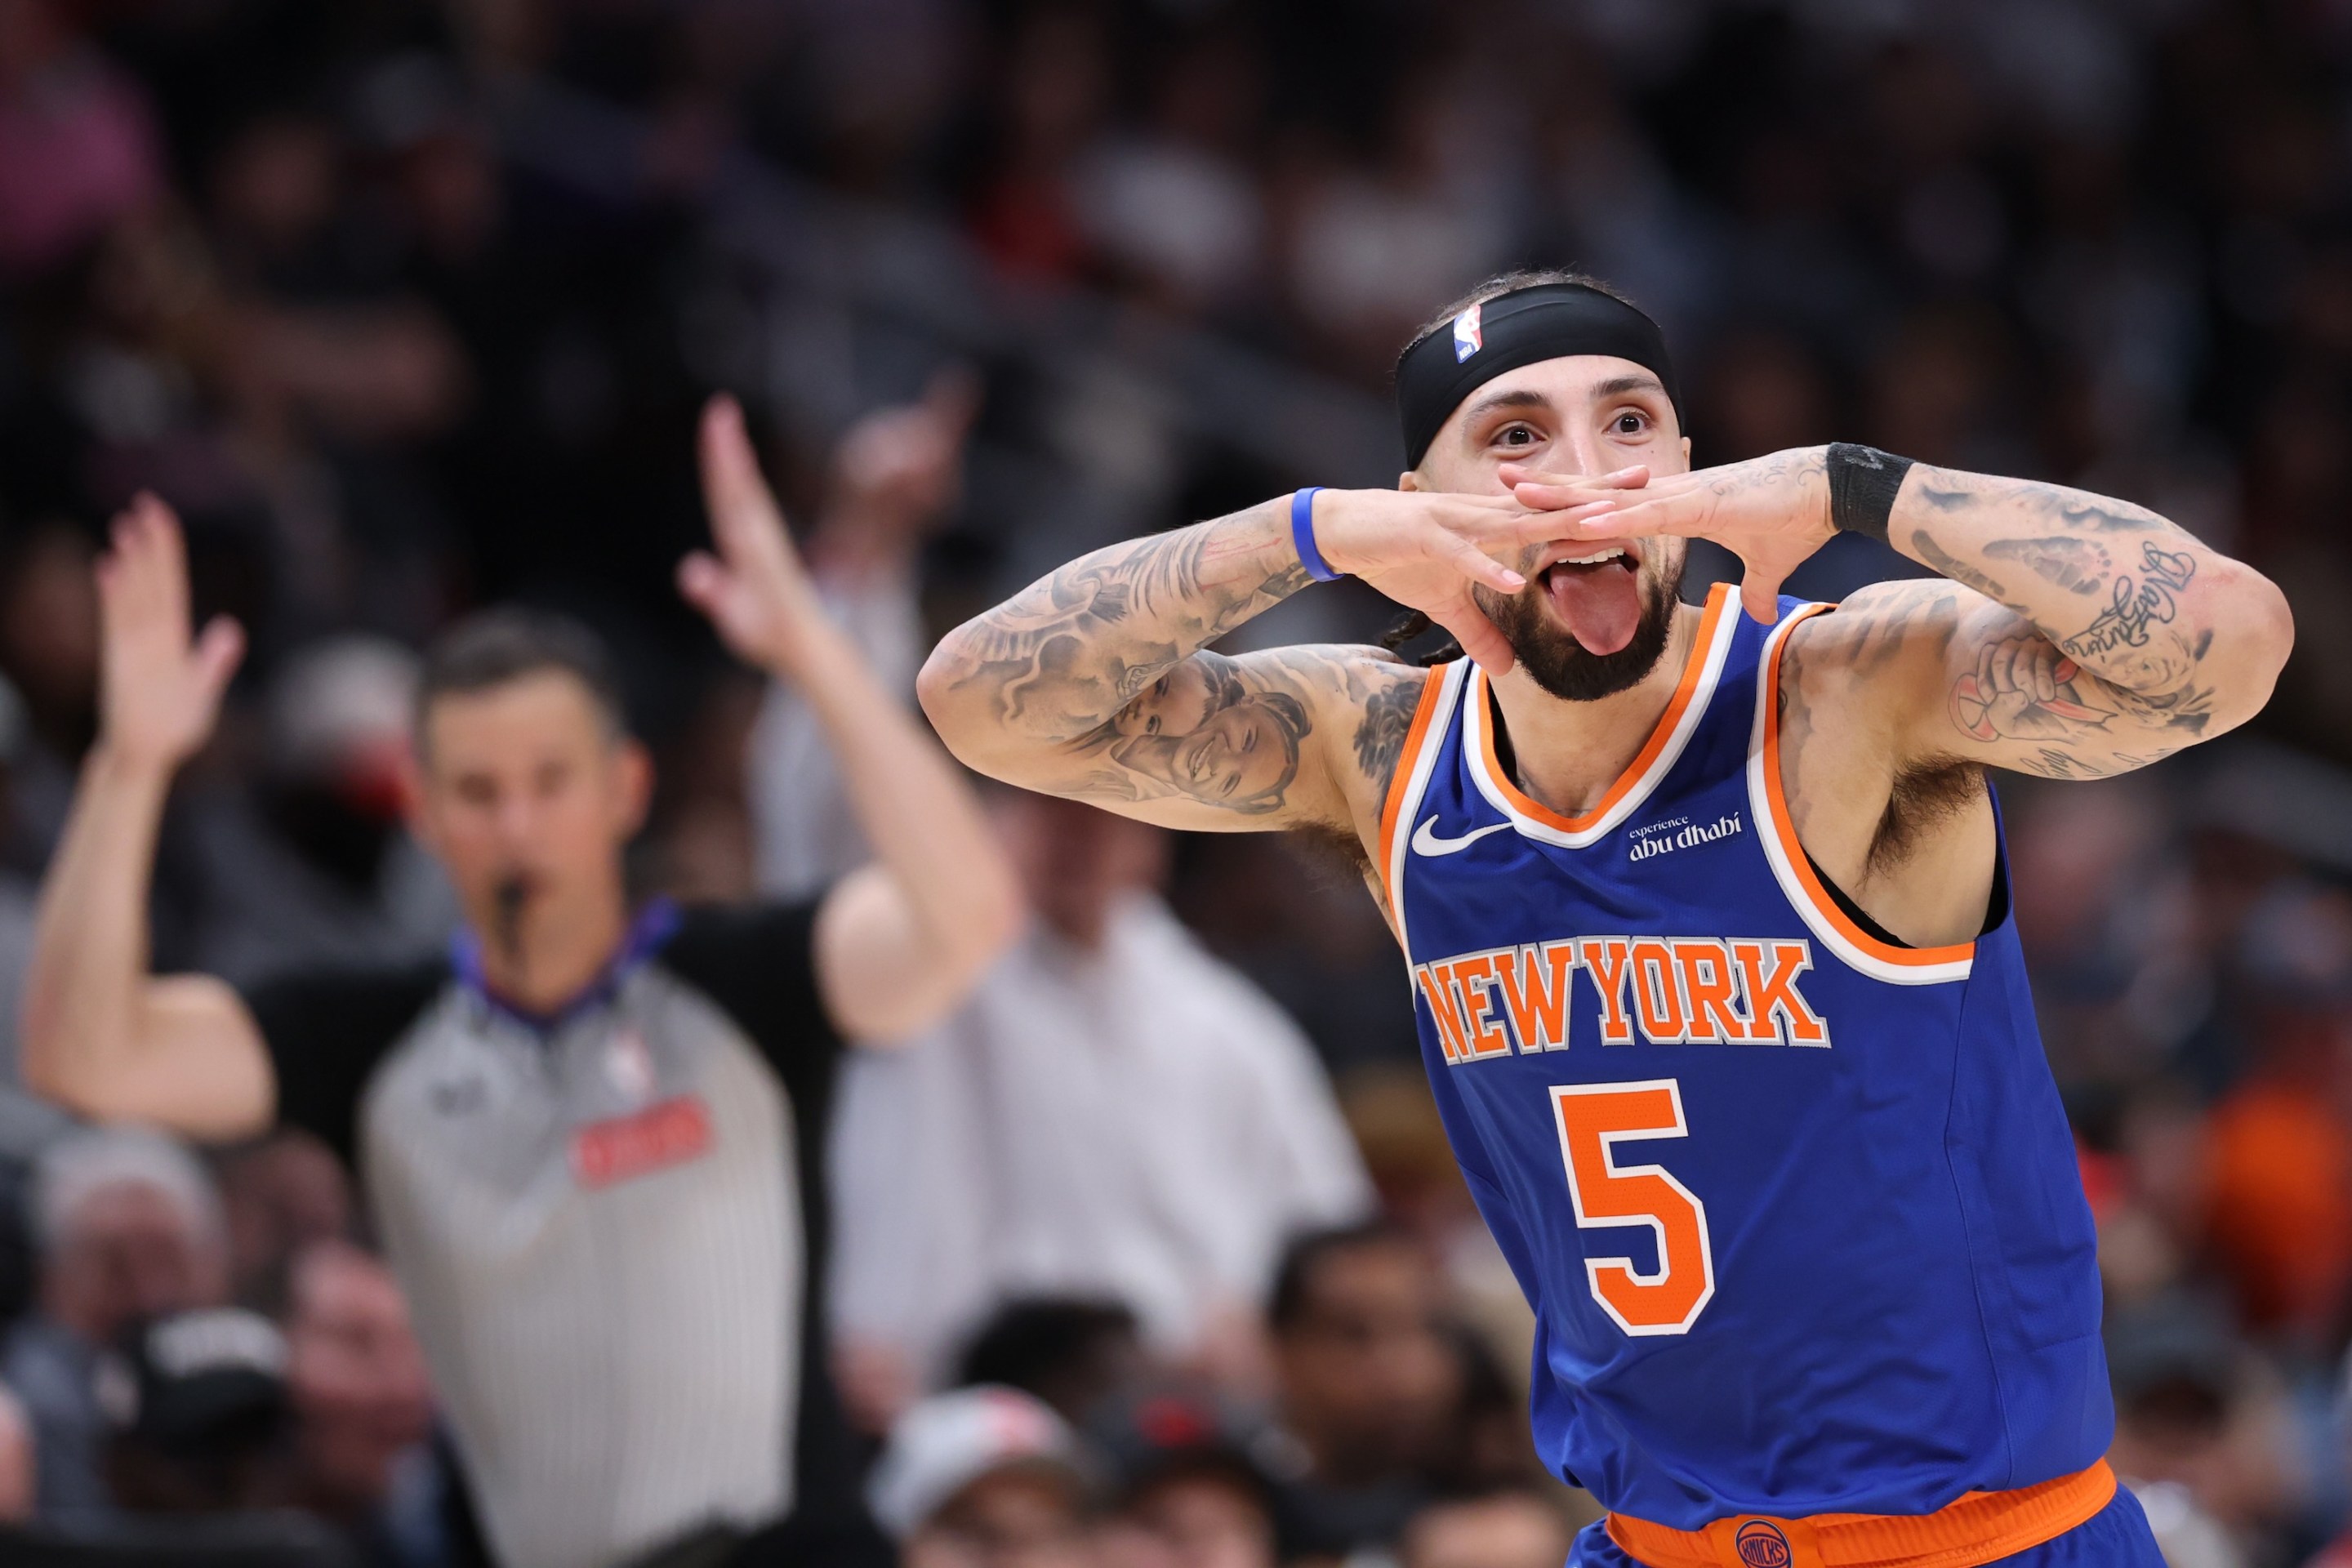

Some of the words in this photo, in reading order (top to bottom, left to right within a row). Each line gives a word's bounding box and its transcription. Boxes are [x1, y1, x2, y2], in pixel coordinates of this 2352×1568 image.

[1459, 344, 1473, 360] NBA
[1629, 817, 1689, 838] experience
[1629, 836, 1674, 862] abu
[1414, 941, 1581, 1066] NEW
[1577, 936, 1832, 1049] YORK
[1548, 1078, 1715, 1337] 5
[1741, 1538, 1784, 1566] KNICKS
